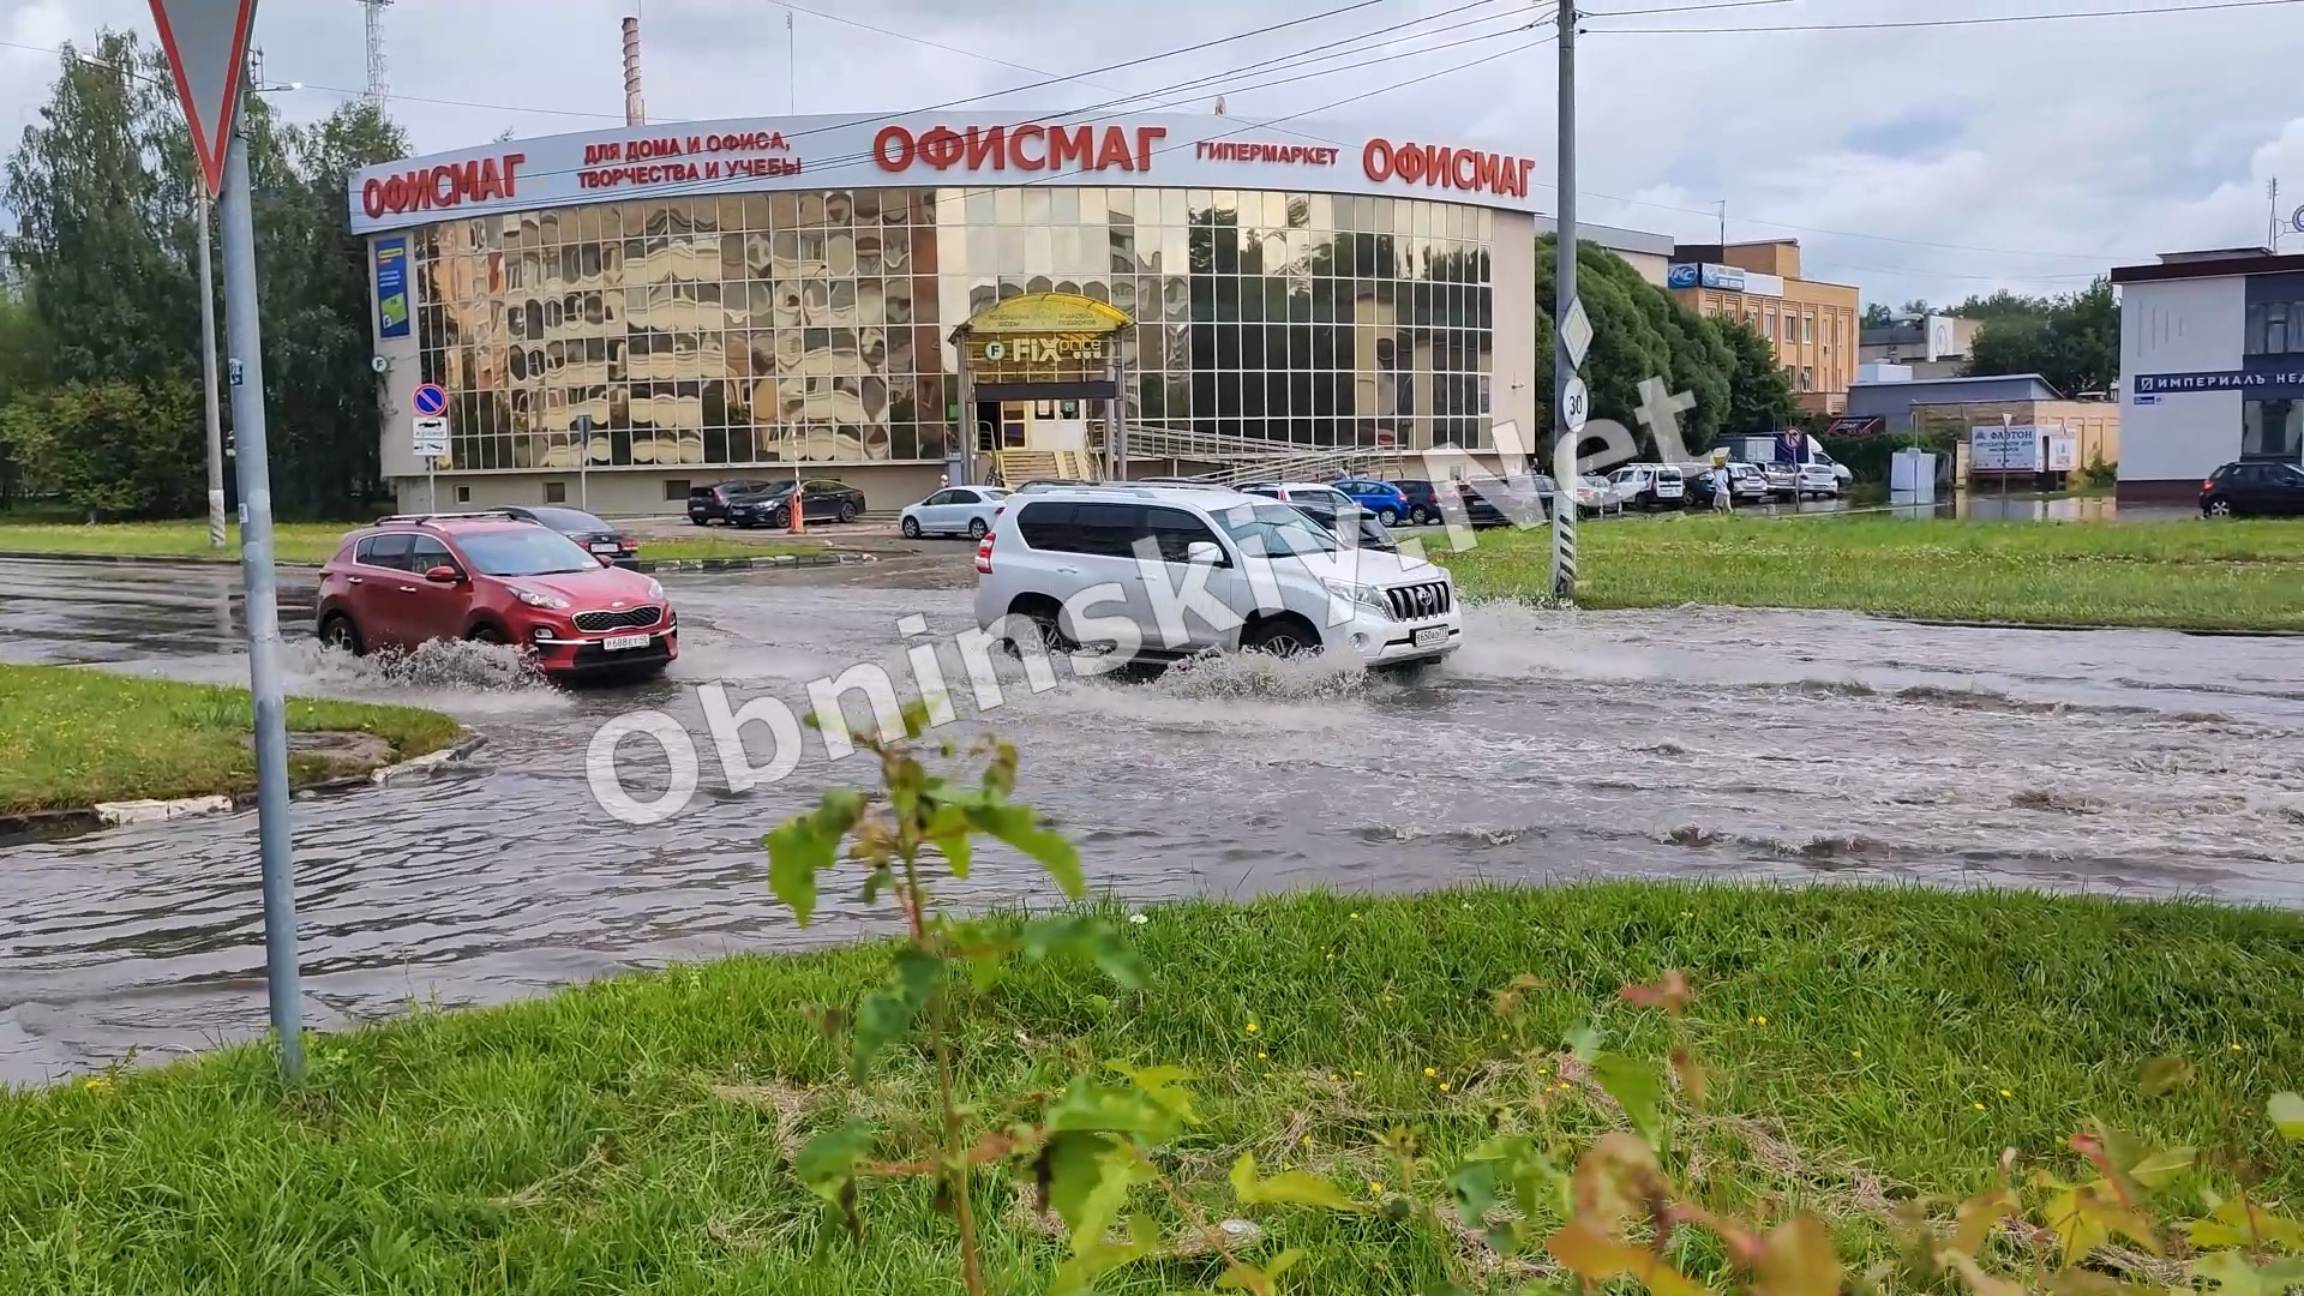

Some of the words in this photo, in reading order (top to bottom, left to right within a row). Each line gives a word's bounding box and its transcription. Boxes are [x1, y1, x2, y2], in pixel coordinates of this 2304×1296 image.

[584, 143, 621, 166] ДЛЯ
[625, 138, 682, 162] ДОМА
[687, 136, 700, 154] И
[706, 131, 790, 152] ОФИСА,
[874, 125, 1166, 172] ОФИСМАГ
[1196, 141, 1339, 165] ГИПЕРМАРКЕТ
[577, 163, 700, 189] ТВОРЧЕСТВА
[705, 161, 719, 180] И
[725, 157, 802, 178] УЧЕБЫ
[1363, 138, 1535, 197] ОФИСМАГ
[362, 153, 525, 218] ОФИСМАГ
[2158, 375, 2265, 388] ИМПЕРИАЛЪ
[1569, 395, 1582, 415] 30
